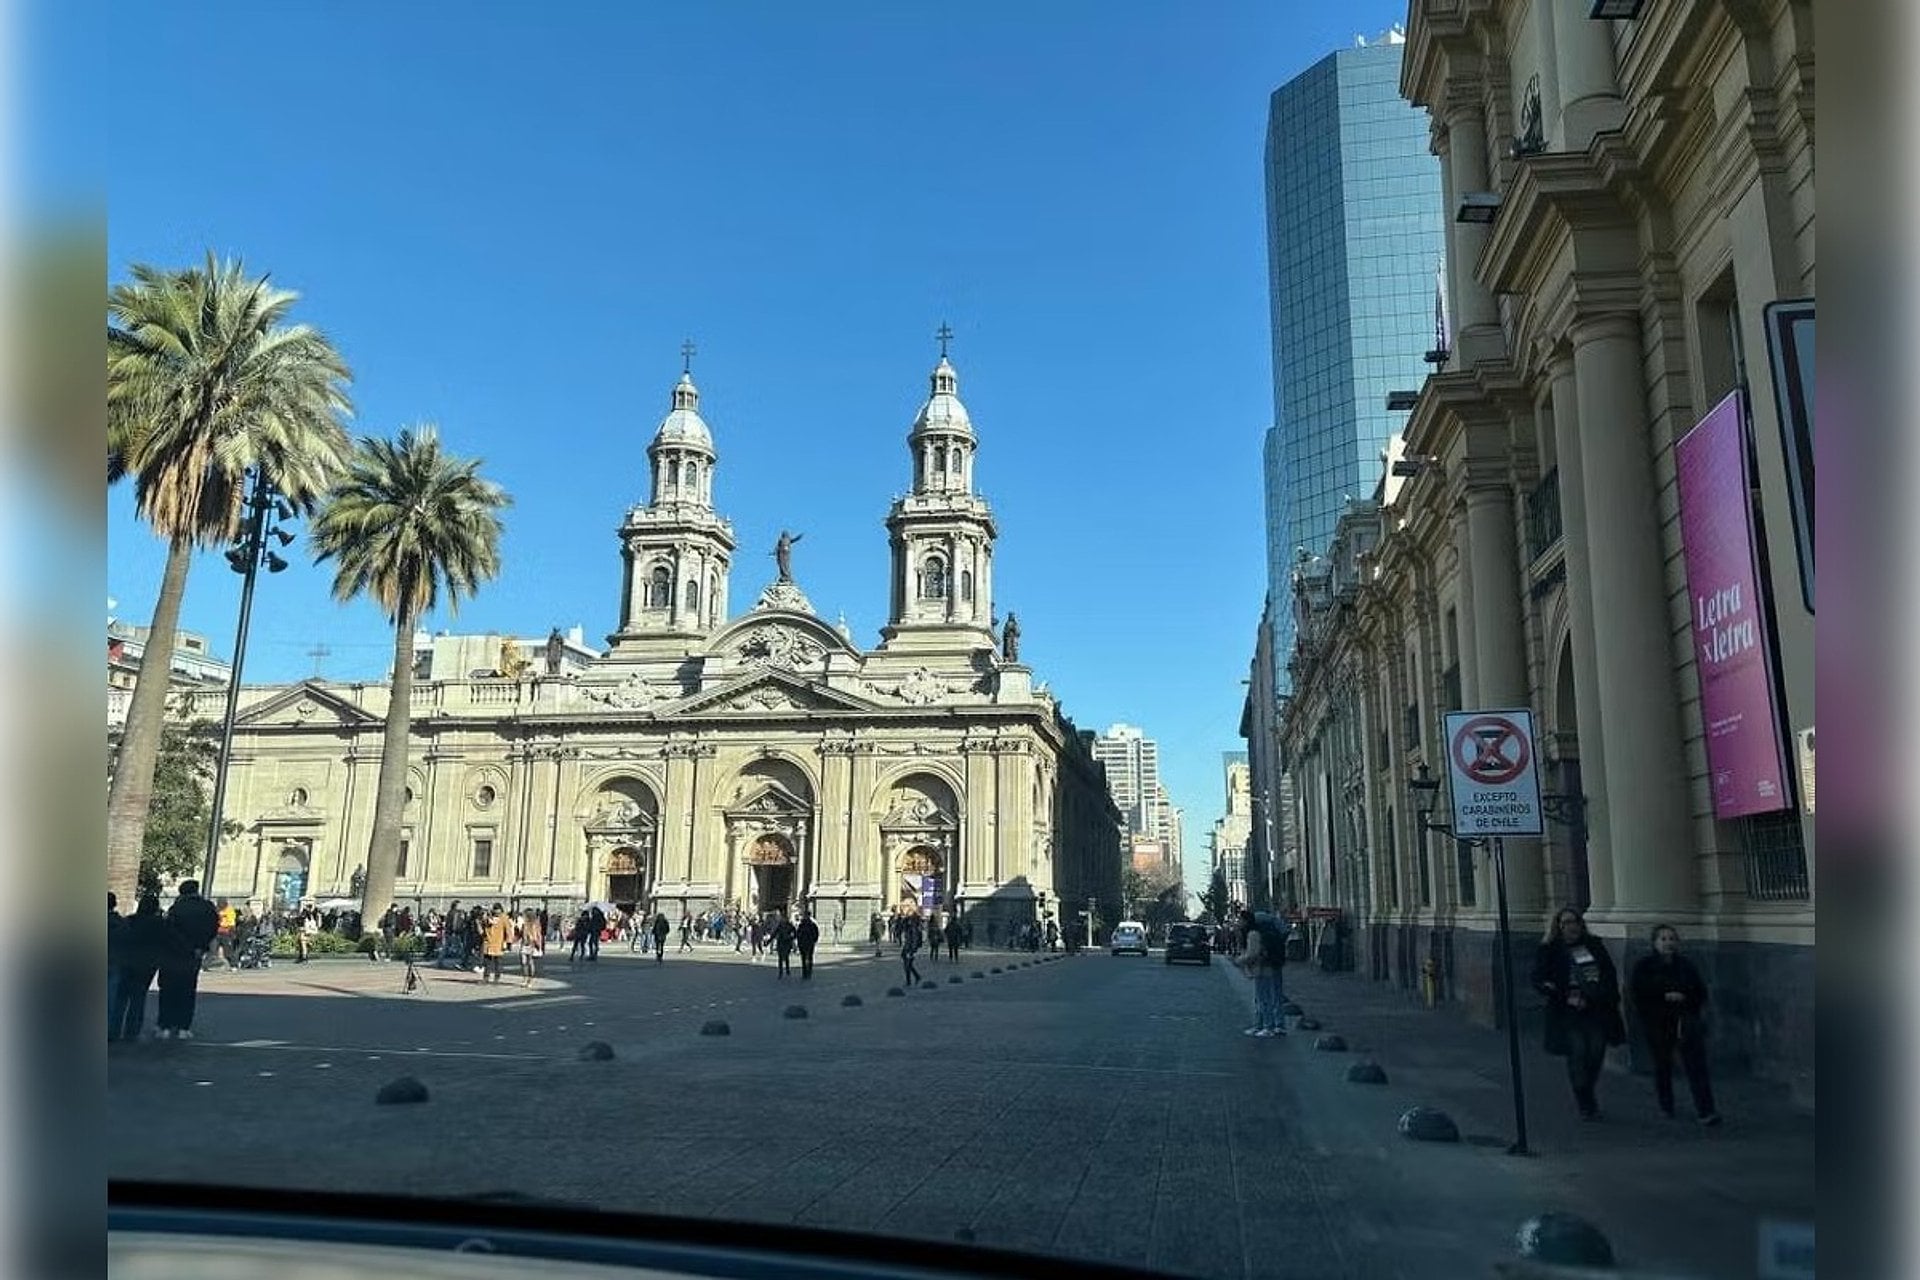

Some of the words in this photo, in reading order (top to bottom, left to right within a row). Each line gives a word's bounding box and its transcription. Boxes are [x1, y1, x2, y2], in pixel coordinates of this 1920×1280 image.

[1698, 582, 1741, 631] Letra
[1713, 619, 1753, 663] letra
[1473, 792, 1517, 802] EXCEPTO
[1462, 803, 1531, 815] CARABINEROS
[1476, 818, 1490, 827] DE
[1491, 817, 1519, 826] CHILE
